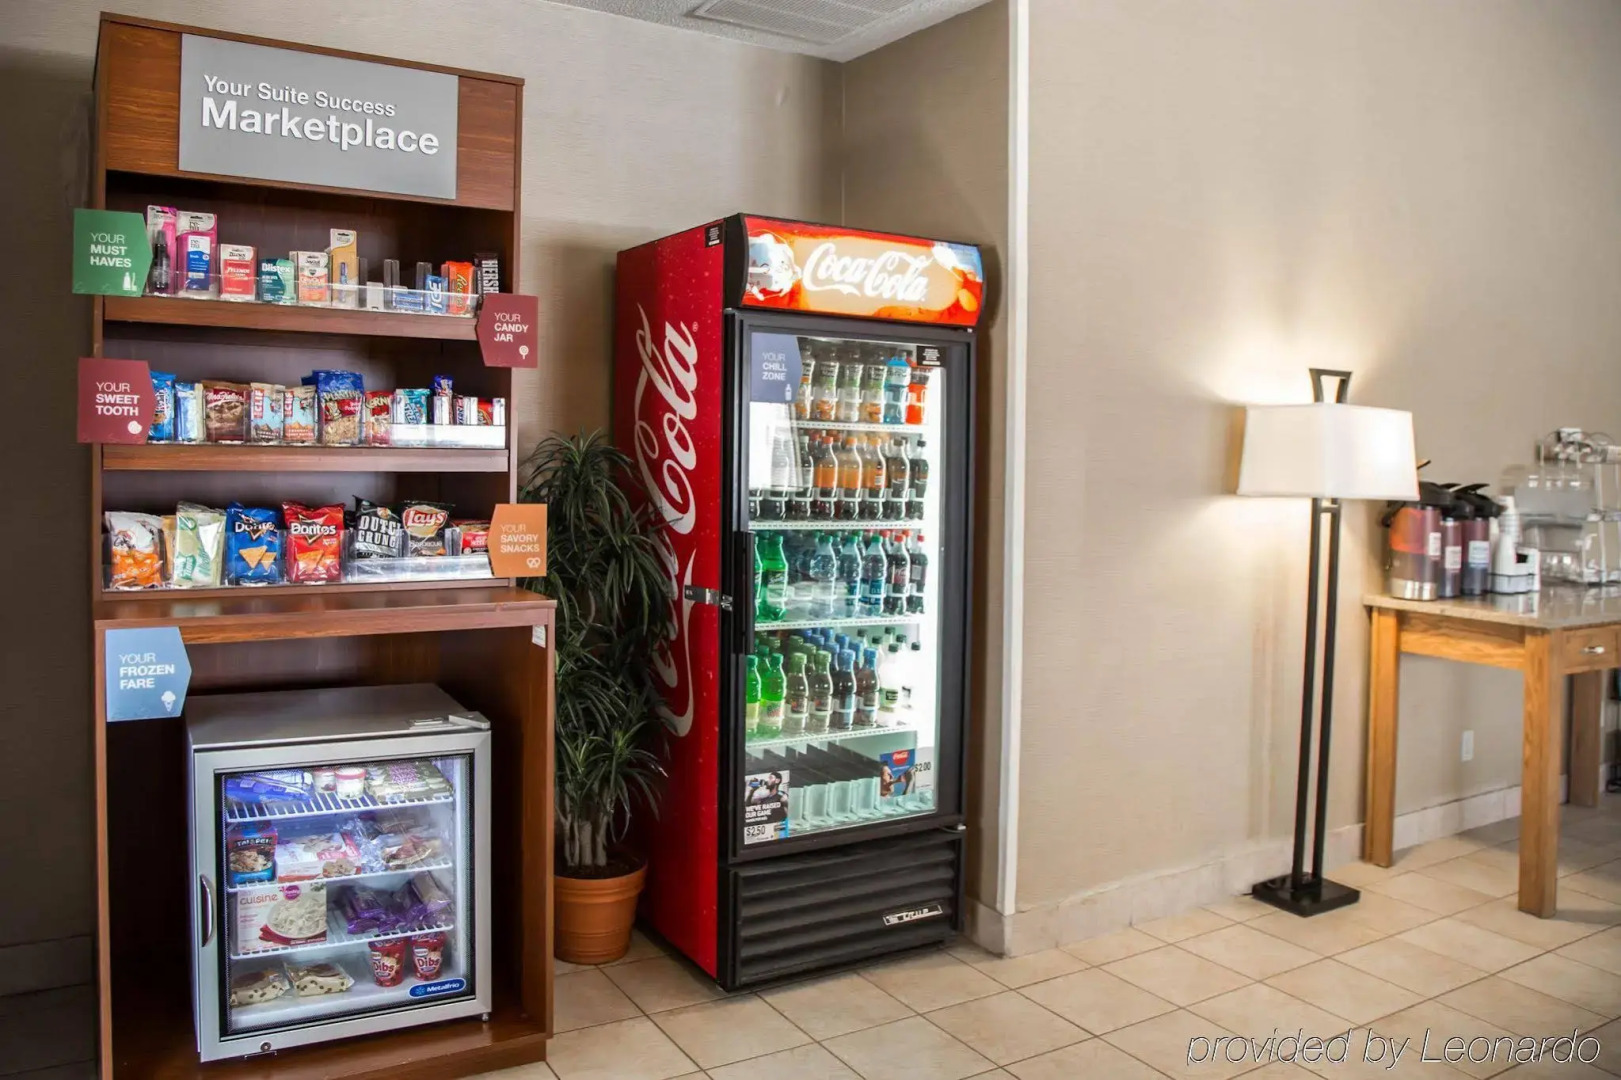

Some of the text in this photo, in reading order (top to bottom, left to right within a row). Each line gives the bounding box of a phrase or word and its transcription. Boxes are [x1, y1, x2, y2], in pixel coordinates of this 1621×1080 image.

[203, 74, 397, 117] Your Suite Success
[201, 97, 440, 155] Marketplace
[90, 232, 125, 244] YOUR
[90, 245, 128, 256] MUST
[89, 256, 132, 268] HAVES
[261, 263, 291, 274] Blistex
[802, 242, 935, 302] Coca-Cola
[482, 260, 499, 294] HERSH
[494, 313, 521, 322] YOUR
[494, 322, 529, 333] CANDY
[494, 333, 514, 342] JAR
[762, 352, 786, 361] YOUR
[762, 362, 787, 371] CHILL
[762, 371, 786, 381] ZONE
[96, 382, 130, 392] YOUR
[95, 393, 140, 405] SWEET
[95, 405, 139, 416] TOOTH
[291, 522, 336, 536] Doritos
[500, 524, 526, 533] YOUR
[500, 534, 539, 543] SAVORY
[500, 544, 540, 553] SNACKS
[119, 652, 156, 664] YOUR
[119, 664, 175, 678] FROZEN
[119, 678, 155, 690] FARE
[240, 893, 279, 906] cuisine
[373, 961, 395, 972] Dibs
[417, 957, 440, 968] Dibs
[427, 983, 460, 992] Metalfrio
